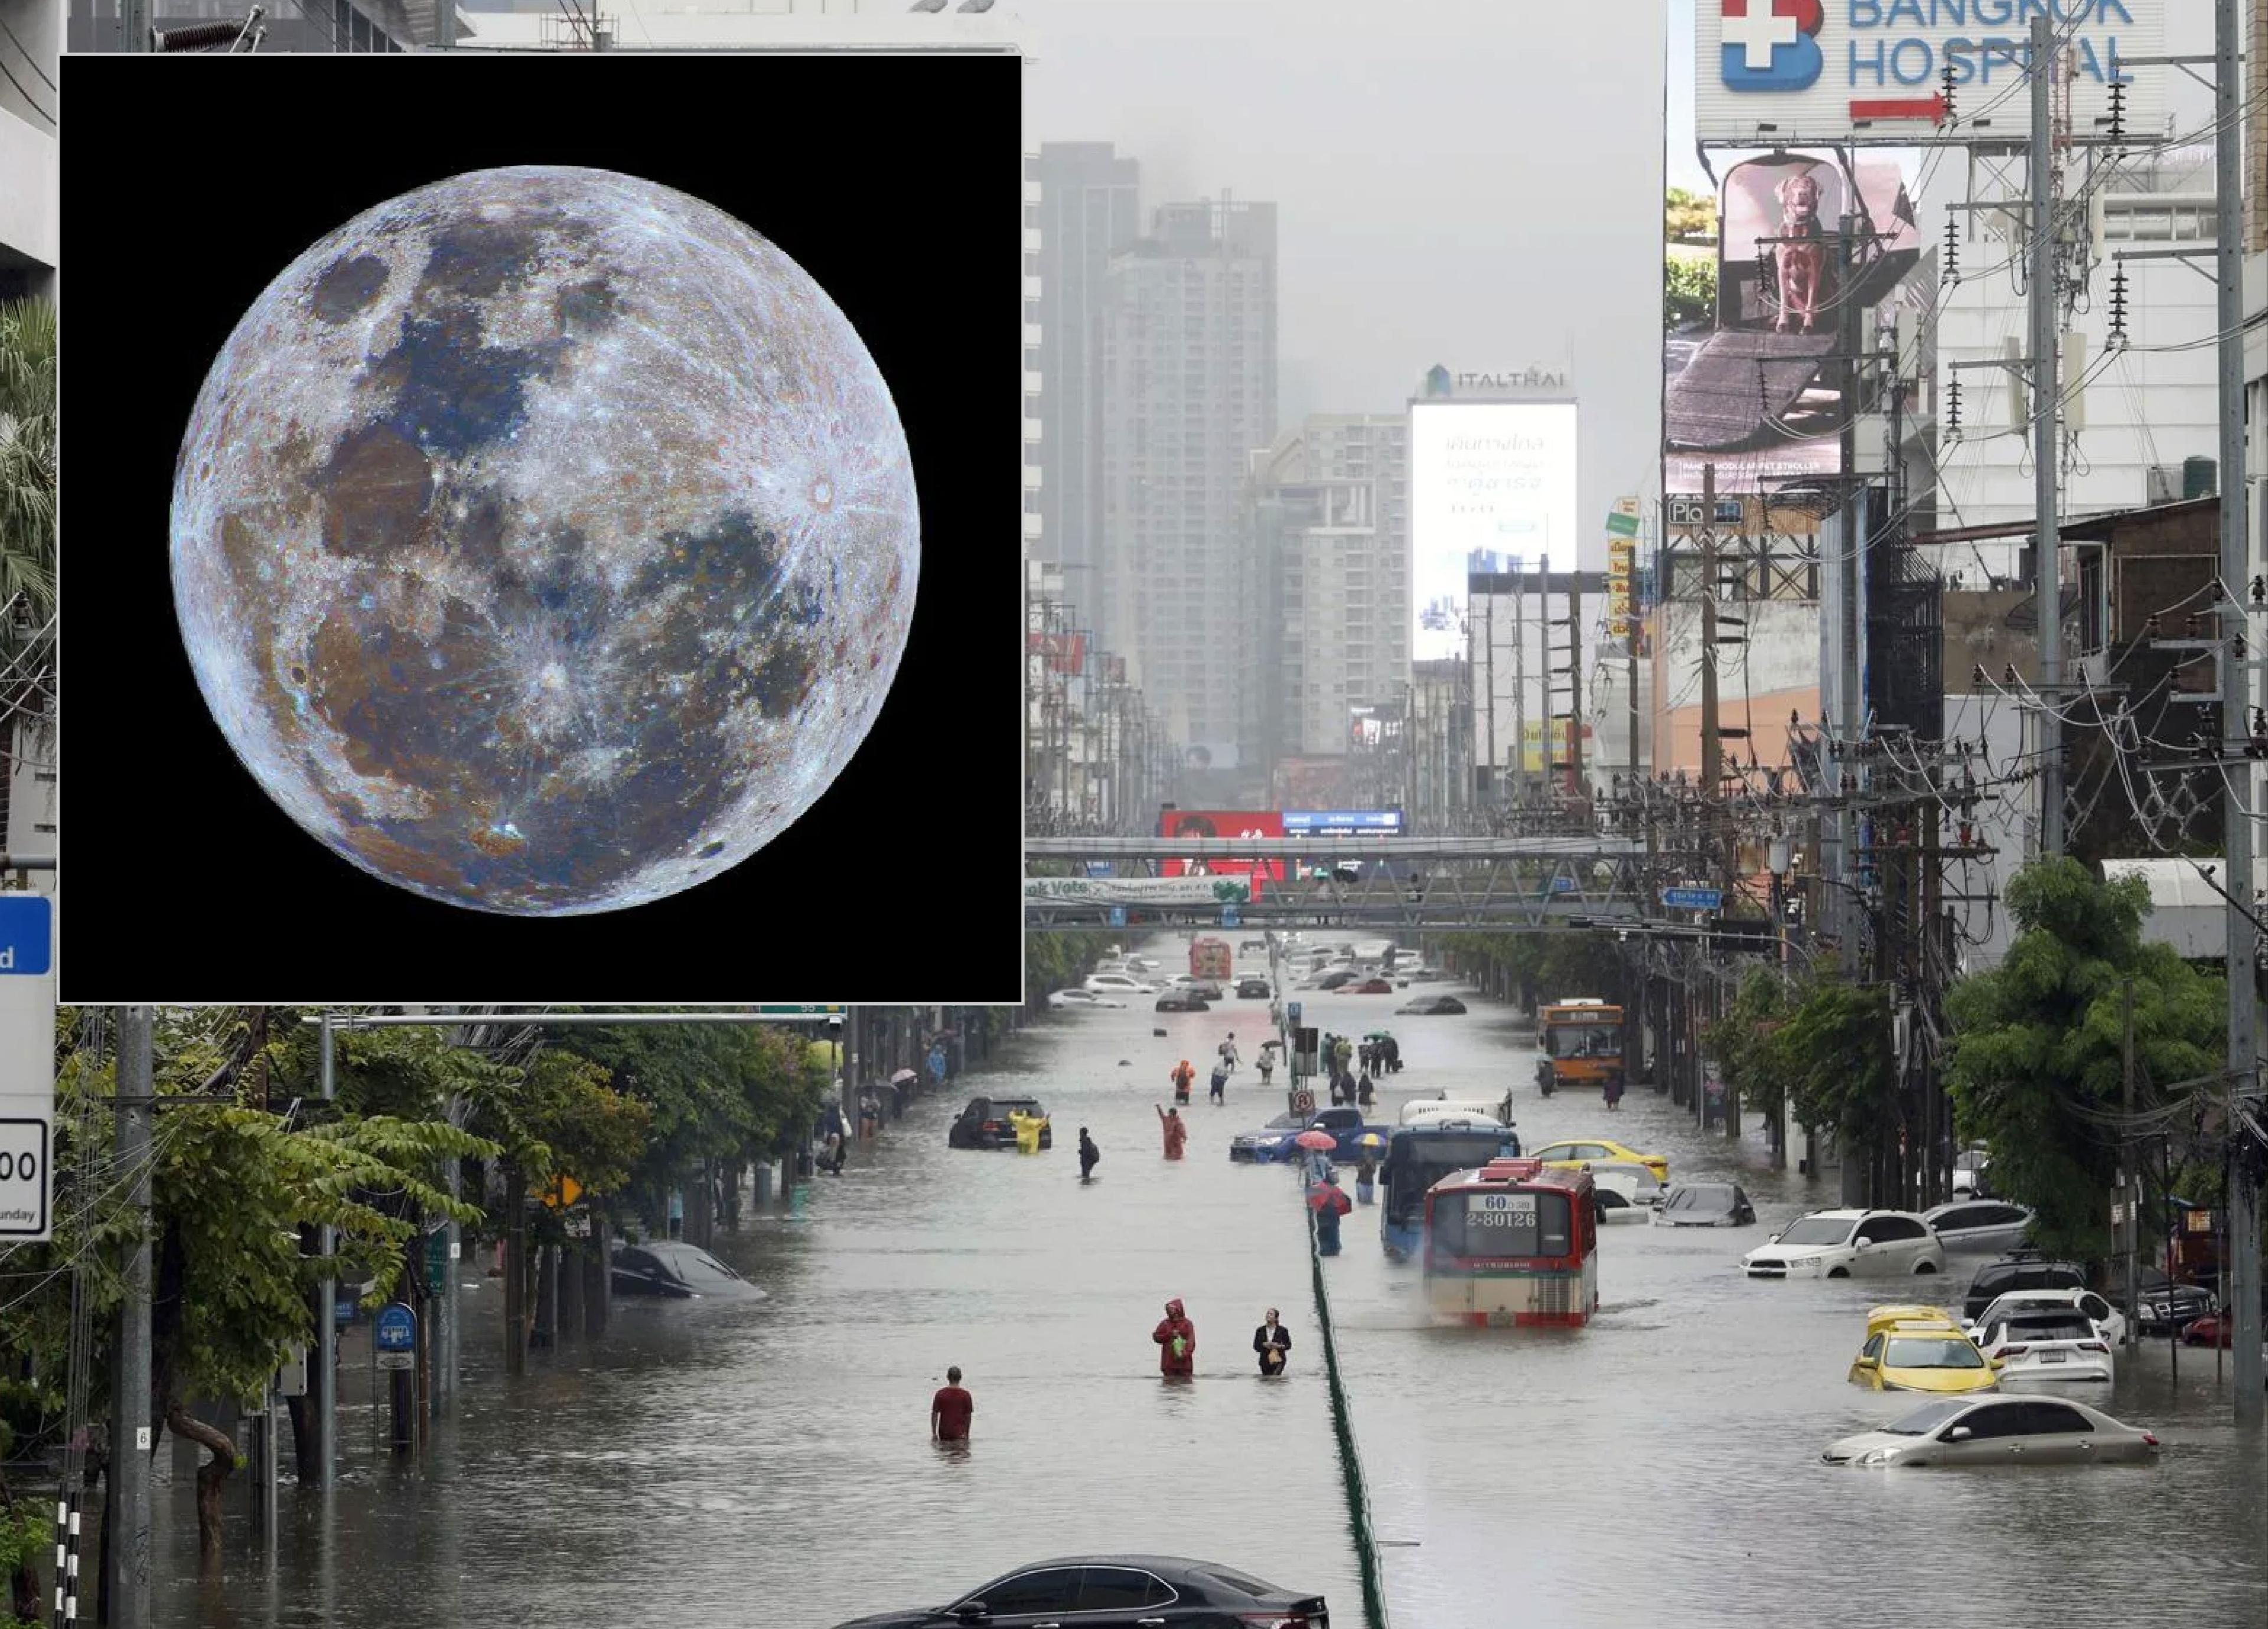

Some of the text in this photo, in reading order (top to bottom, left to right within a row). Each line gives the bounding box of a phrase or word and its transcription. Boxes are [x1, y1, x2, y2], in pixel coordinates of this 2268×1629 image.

[1850, 0, 2134, 27] BANGKOK
[1459, 373, 1563, 386] ITALTHAI
[0, 1152, 35, 1181] 00
[1485, 1195, 1507, 1210] 60
[1467, 1211, 1536, 1227] 2-80126
